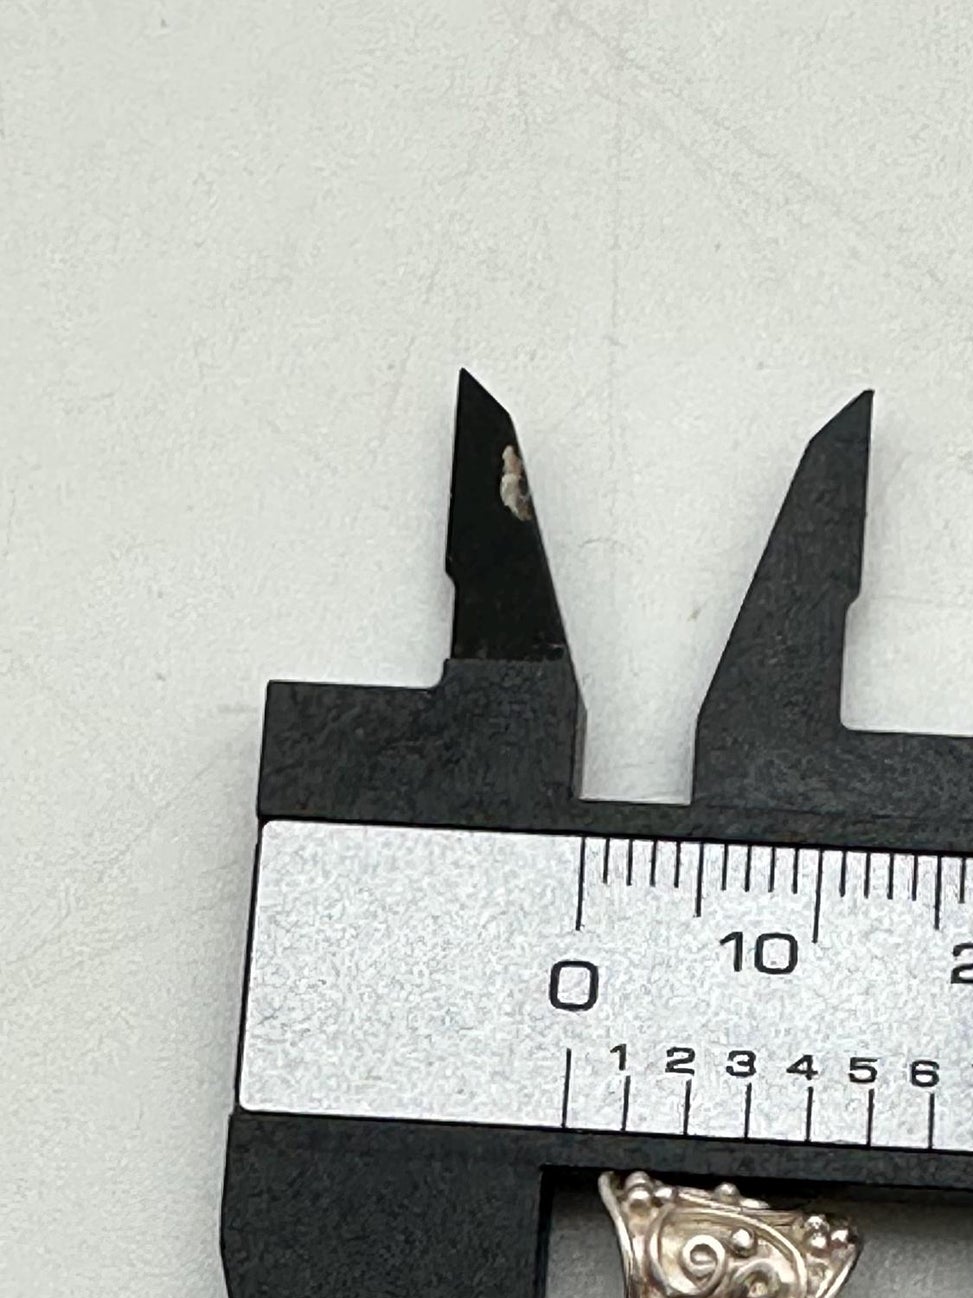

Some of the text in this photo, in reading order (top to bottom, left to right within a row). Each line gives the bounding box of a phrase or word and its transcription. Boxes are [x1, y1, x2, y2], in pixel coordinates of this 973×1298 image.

[549, 960, 599, 1012] 0
[719, 930, 799, 976] 10
[610, 1043, 628, 1071] 1
[665, 1047, 696, 1076] 2
[725, 1050, 757, 1078] 3
[787, 1054, 818, 1081] 4
[849, 1057, 878, 1085] 5
[910, 1060, 940, 1088] 6
